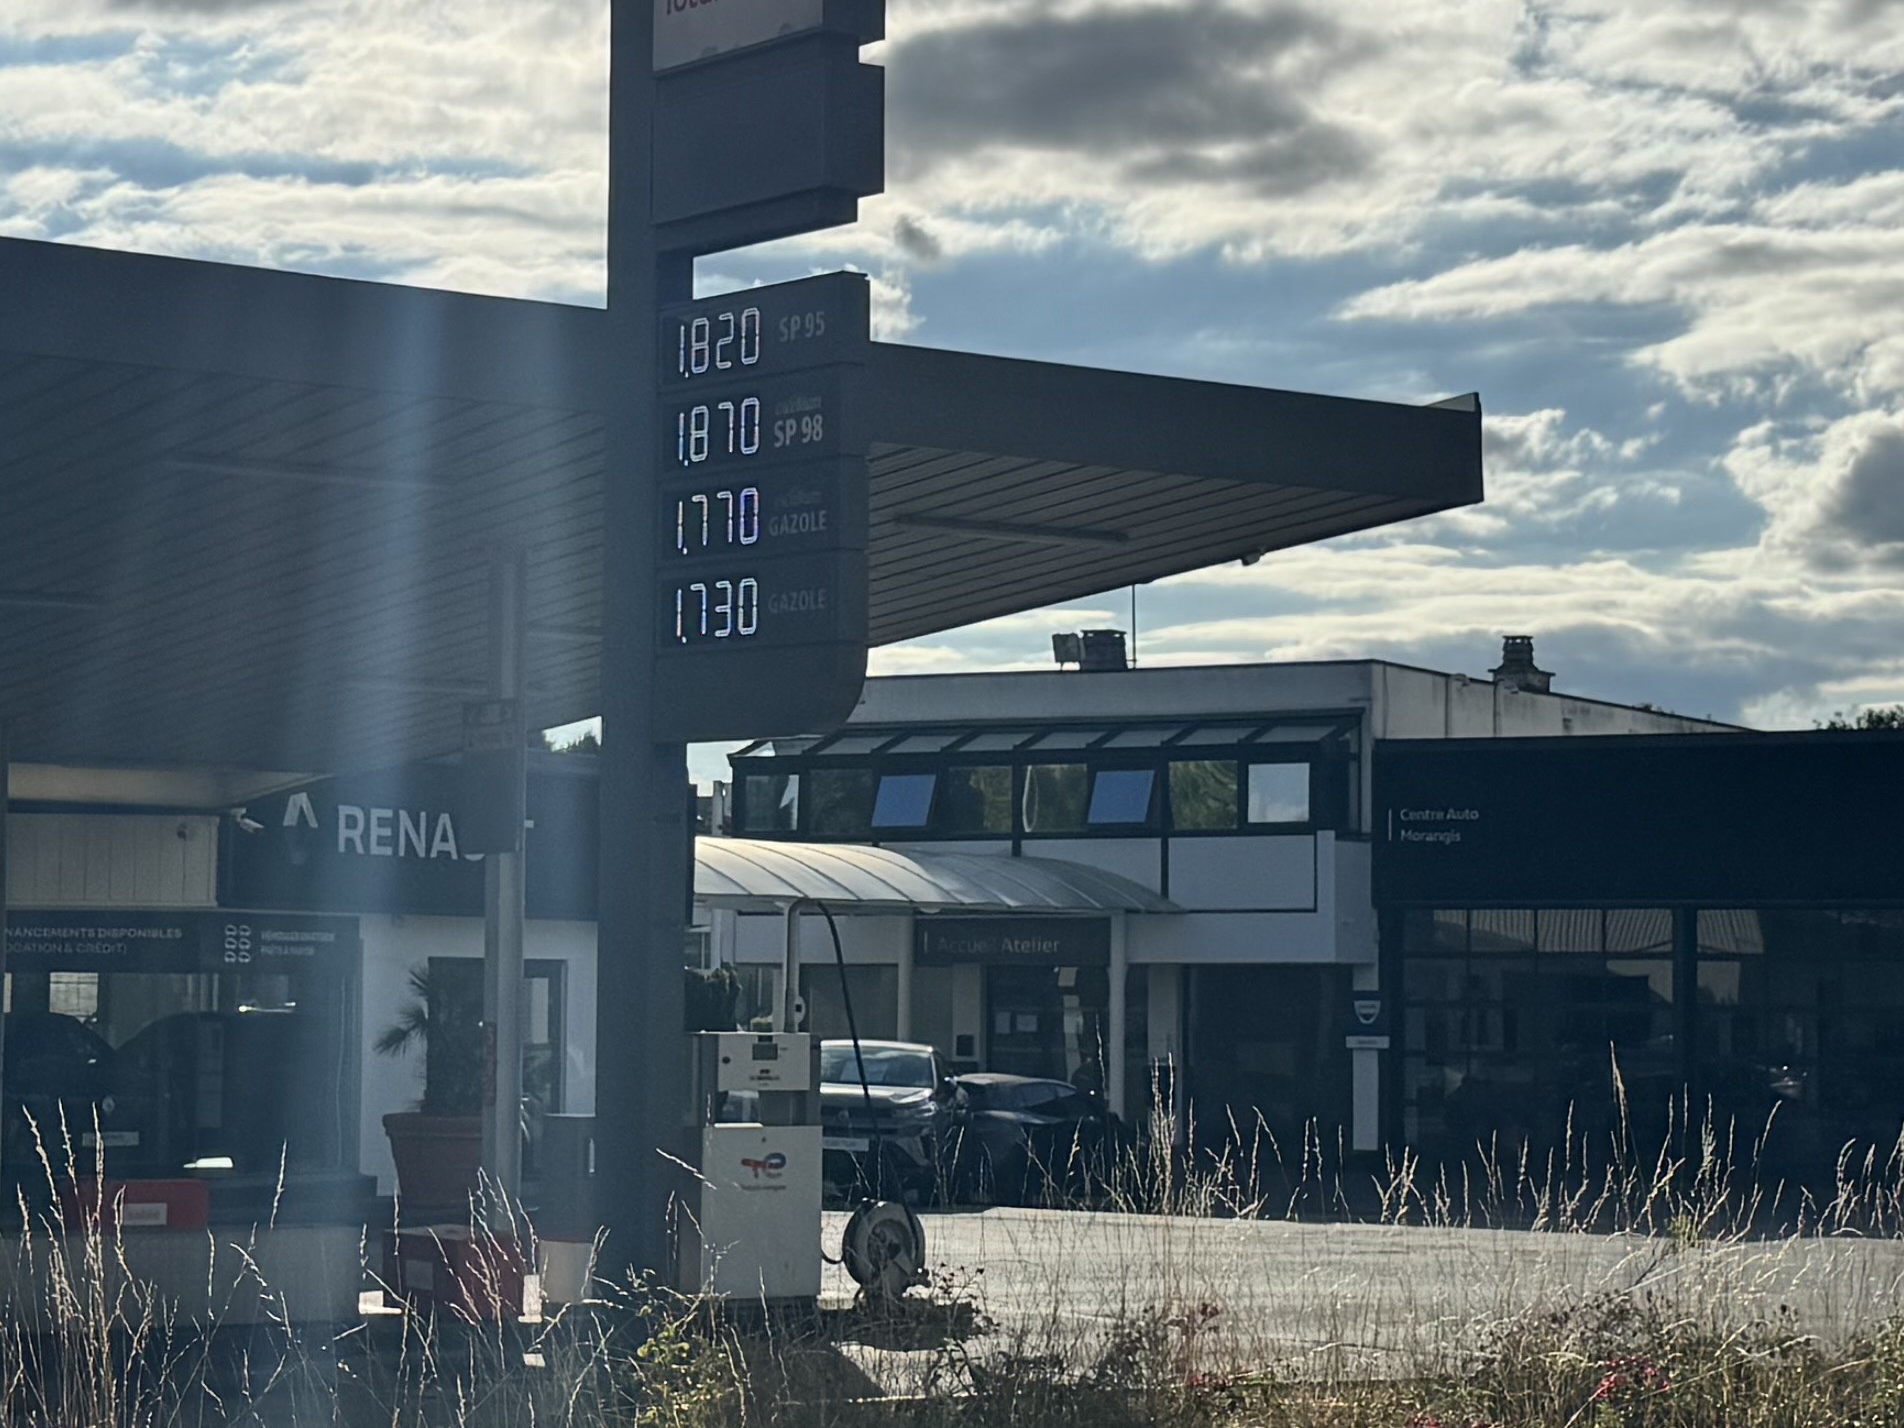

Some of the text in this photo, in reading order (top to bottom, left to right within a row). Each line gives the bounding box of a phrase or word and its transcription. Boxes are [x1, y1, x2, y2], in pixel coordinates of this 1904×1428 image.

[779, 315, 800, 342] SP
[805, 311, 825, 338] 95
[774, 419, 797, 448] SP
[801, 414, 823, 443] 98
[769, 510, 827, 536] GAZOLE
[768, 588, 828, 614] GAZOLE
[1400, 808, 1479, 822] Centre Auto
[338, 804, 485, 861] RENA
[1400, 829, 1461, 845] Morangis
[1001, 936, 1060, 954] Atelier
